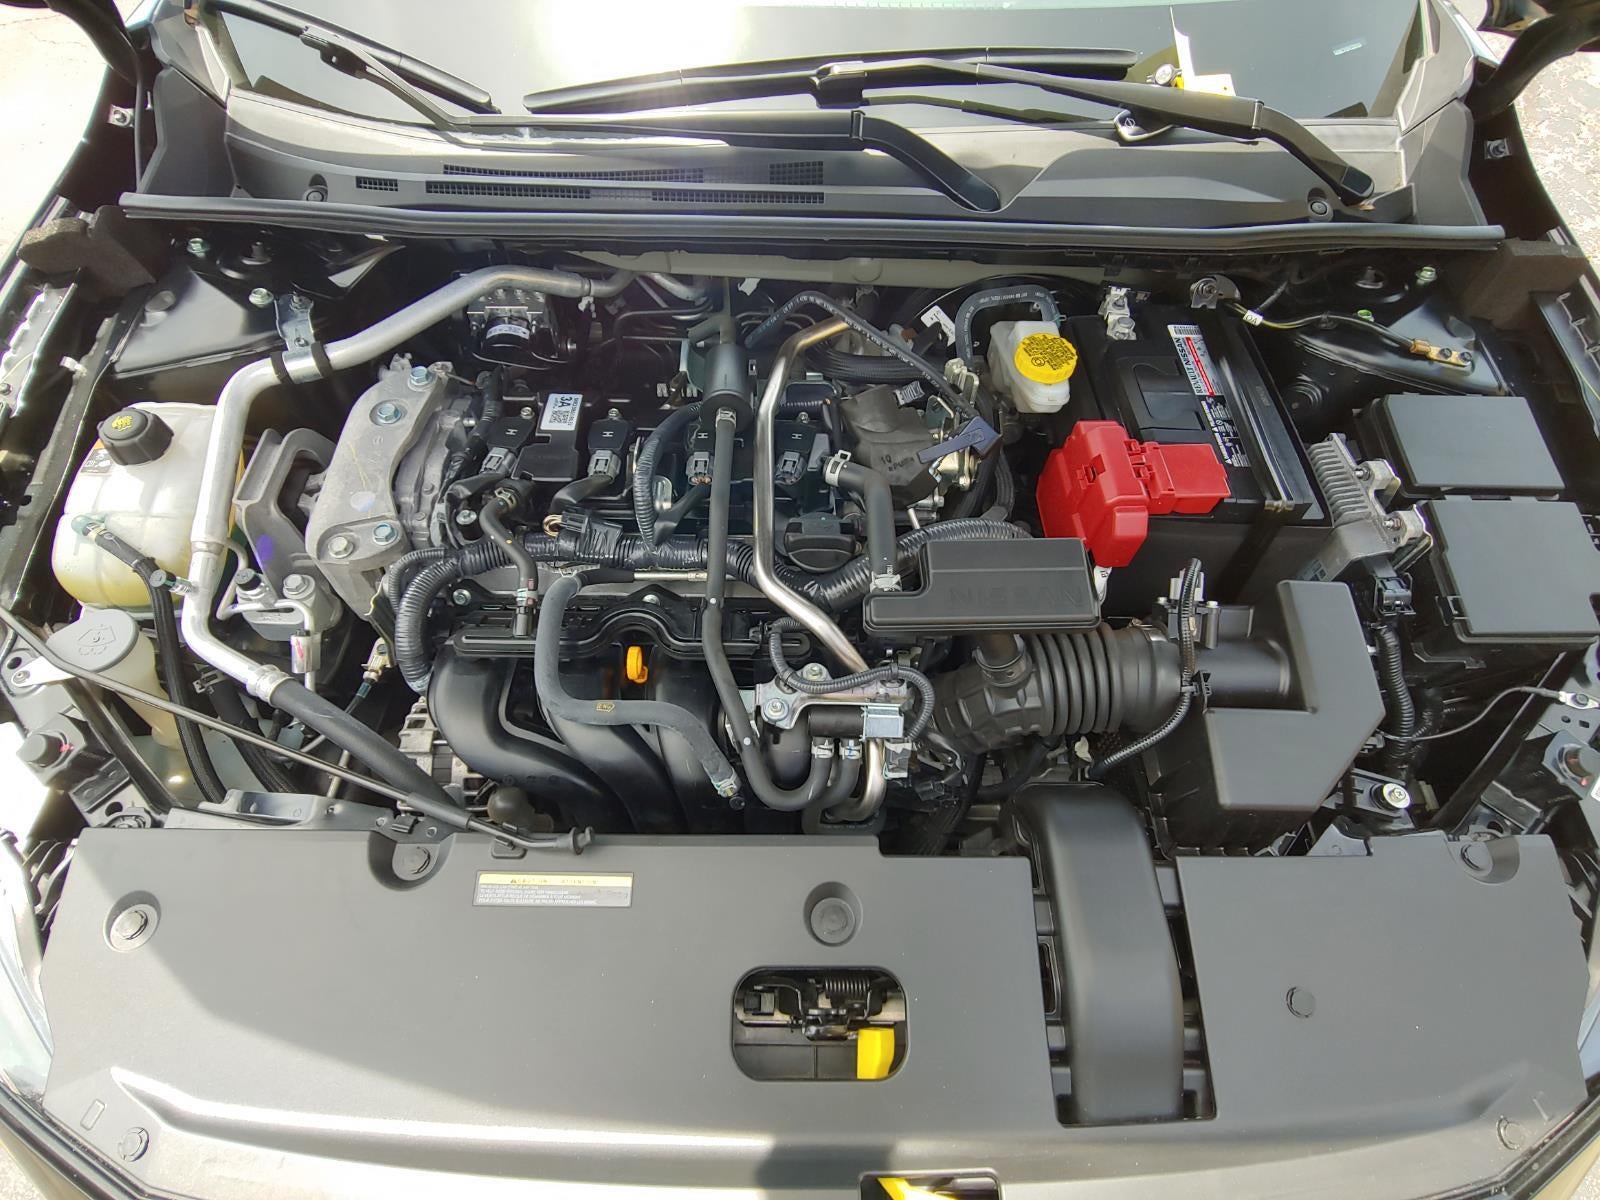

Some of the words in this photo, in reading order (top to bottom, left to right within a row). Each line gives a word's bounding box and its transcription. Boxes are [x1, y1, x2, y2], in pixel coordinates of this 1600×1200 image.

[1174, 337, 1191, 366] NISSAN
[1187, 366, 1204, 394] RENAULT
[558, 396, 572, 408] 3A
